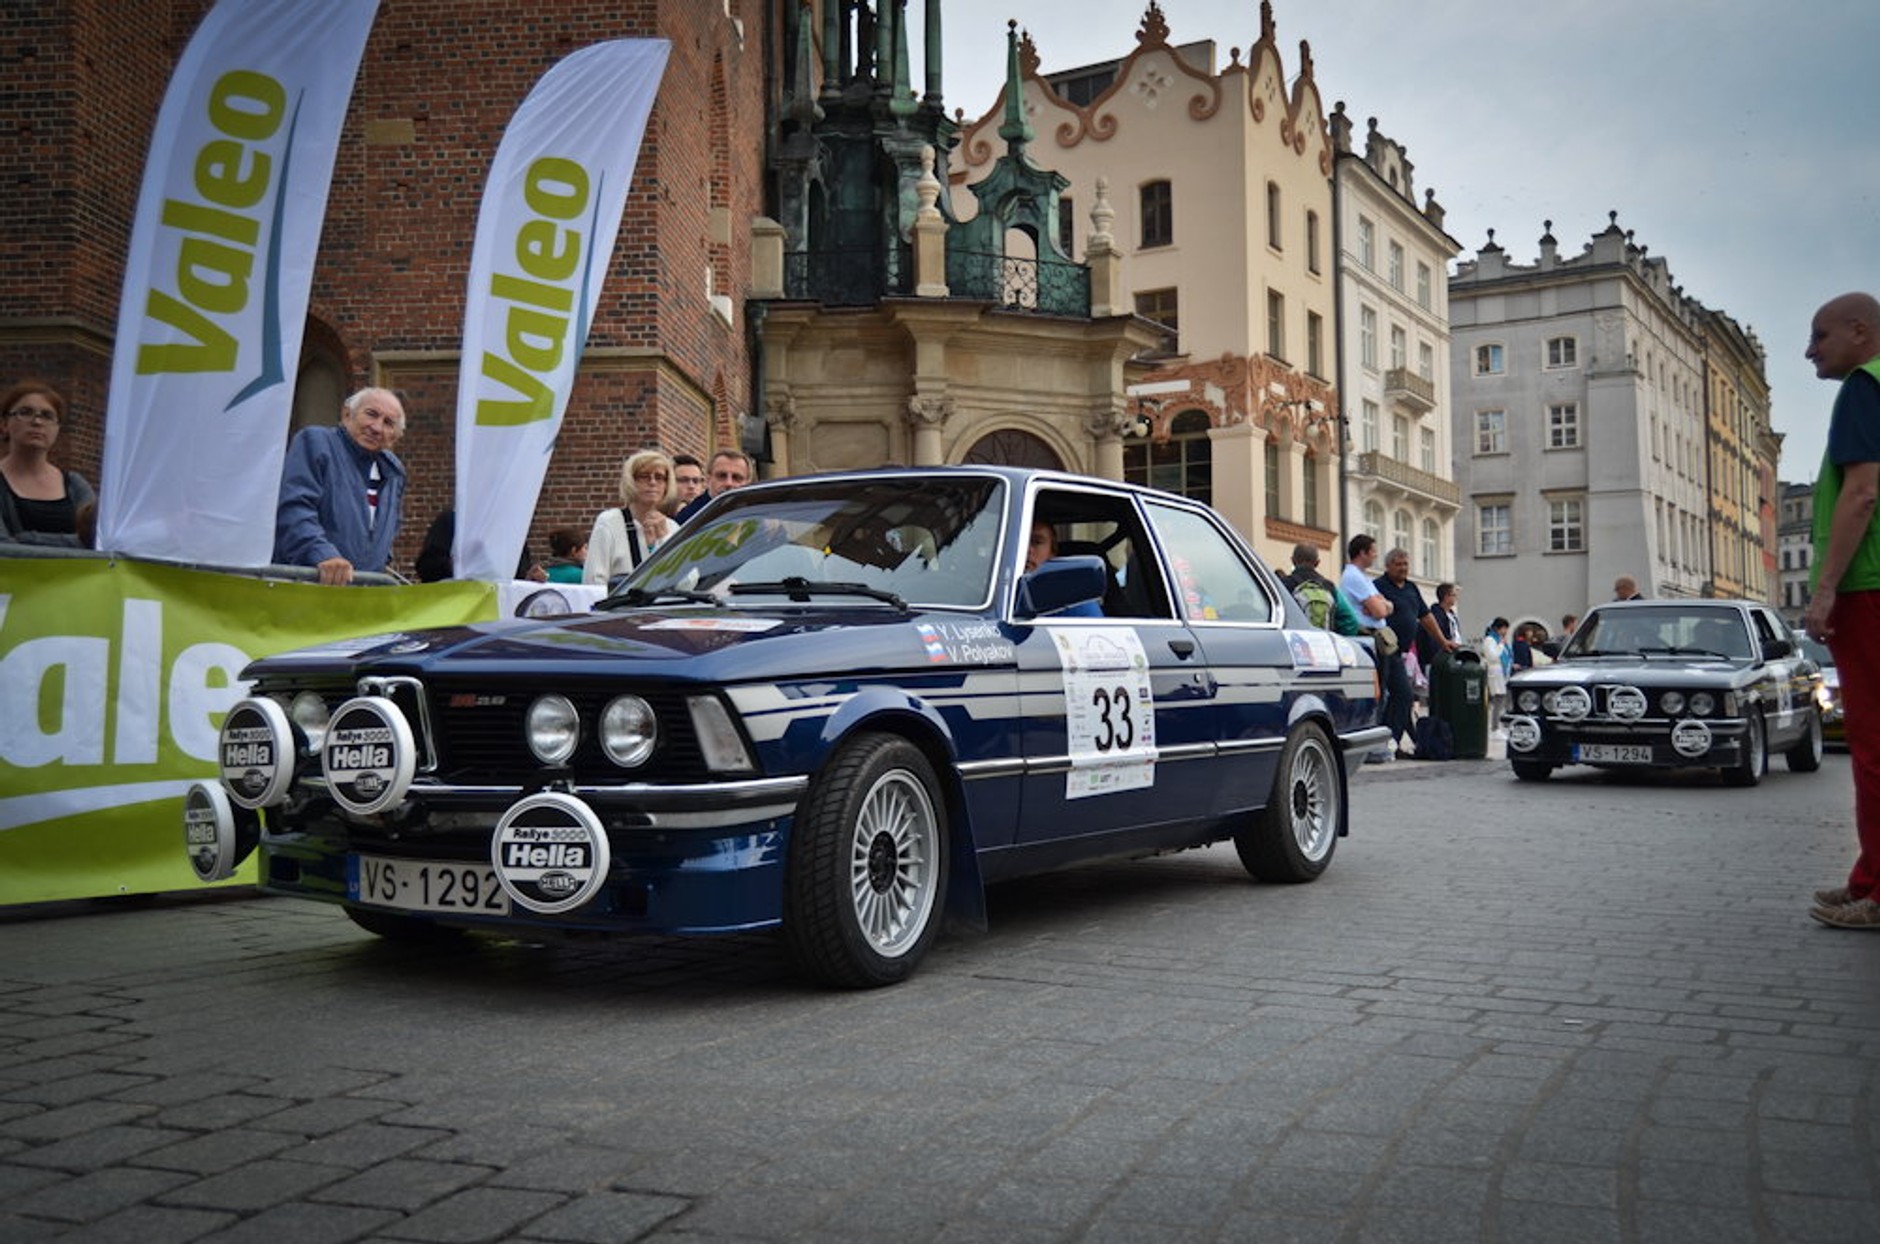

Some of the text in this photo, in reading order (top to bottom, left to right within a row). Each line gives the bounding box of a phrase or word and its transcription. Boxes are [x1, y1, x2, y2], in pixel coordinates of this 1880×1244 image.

[135, 69, 287, 376] Valeo
[475, 157, 590, 427] Valeo
[0, 594, 260, 767] ale
[1093, 686, 1134, 753] 33
[226, 743, 270, 766] Hella
[332, 745, 389, 769] Hella
[508, 844, 585, 867] Hella
[513, 828, 550, 841] Rallye
